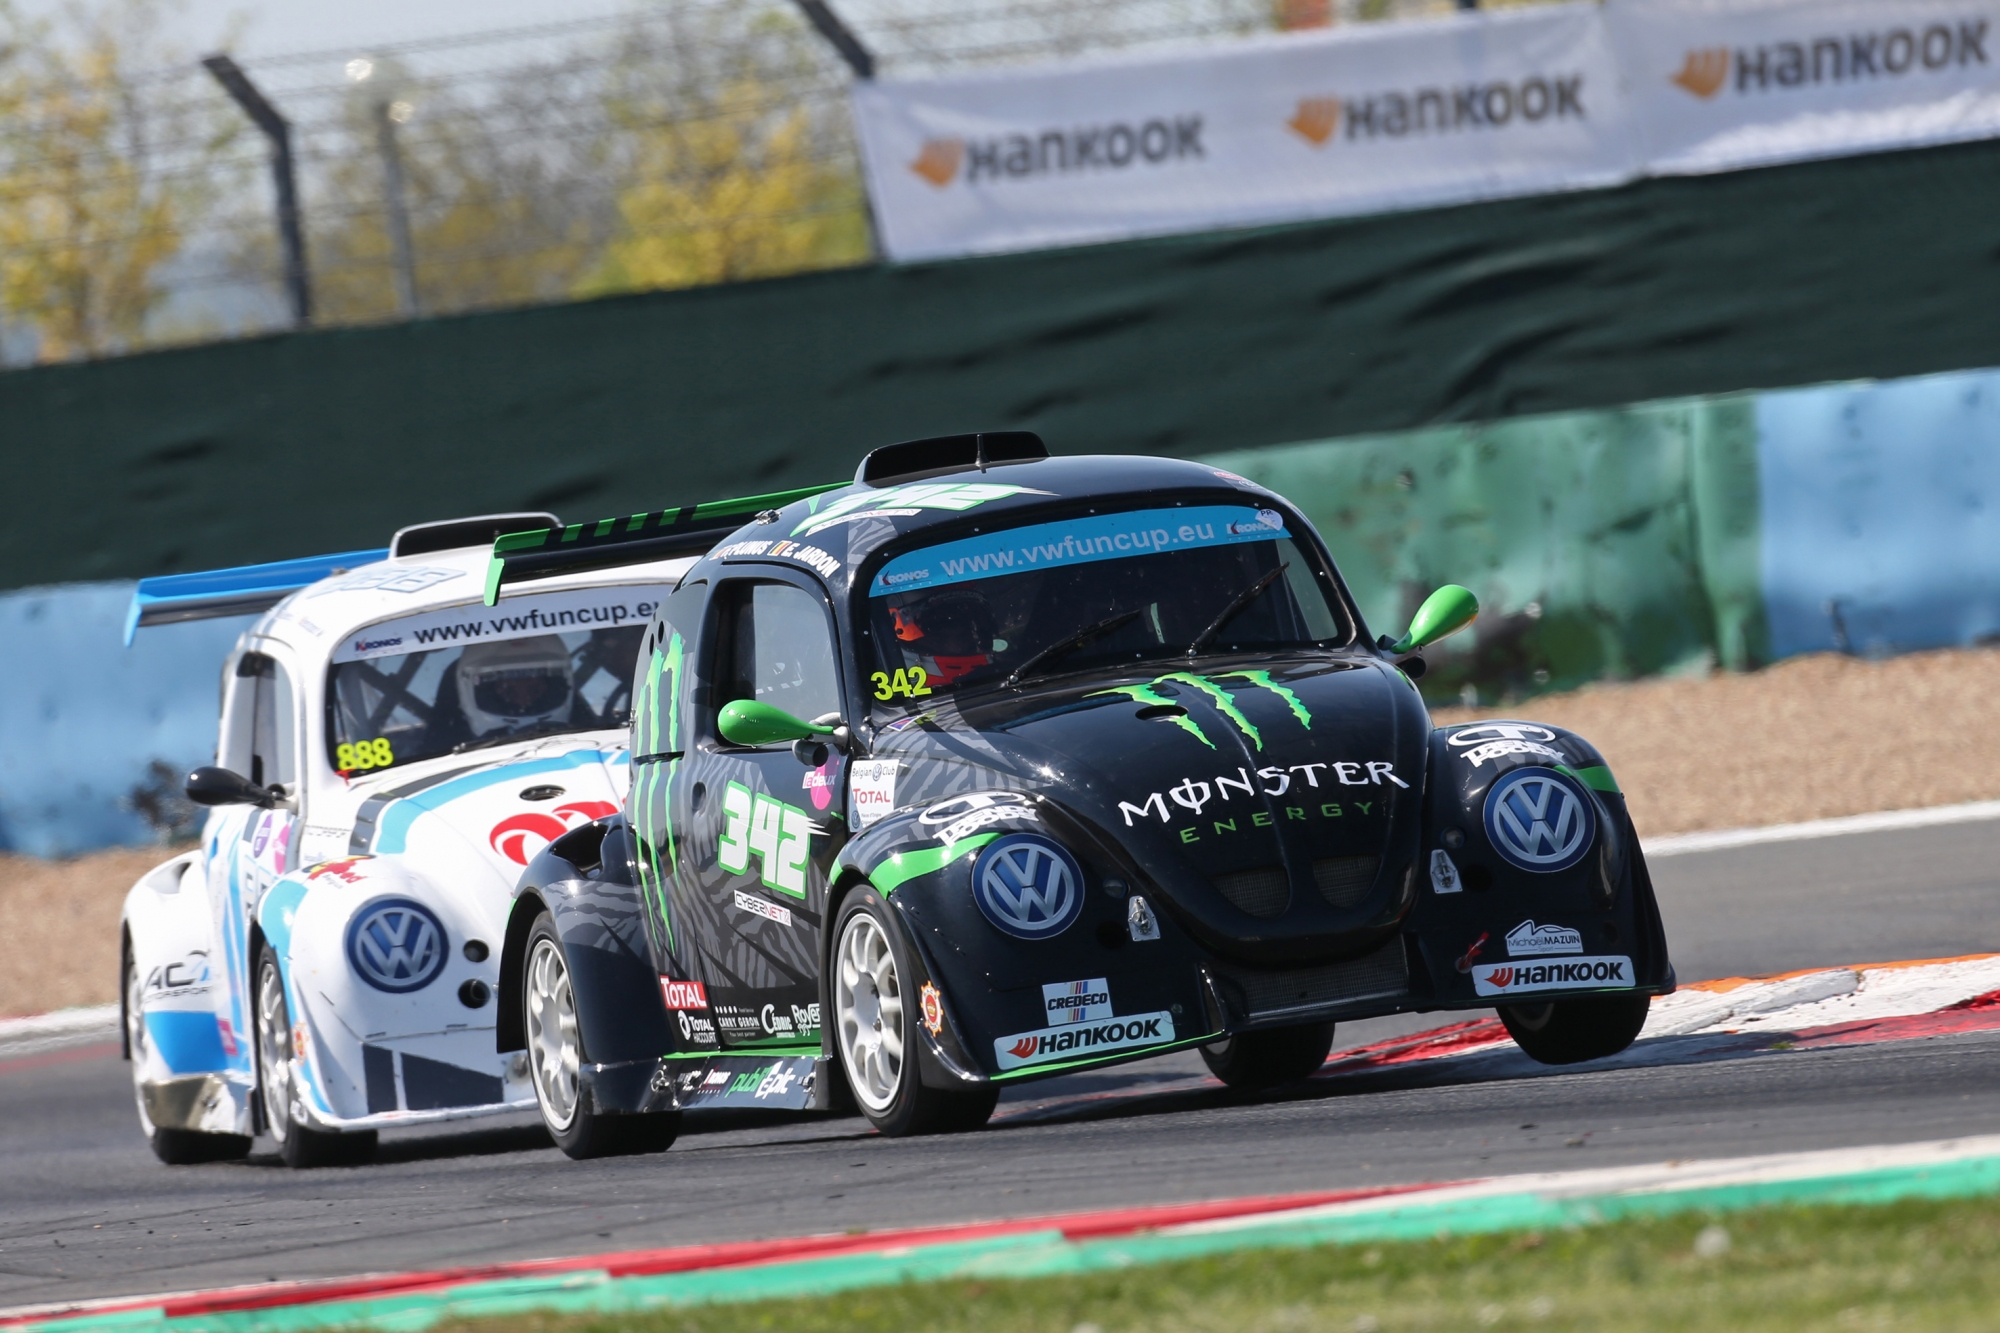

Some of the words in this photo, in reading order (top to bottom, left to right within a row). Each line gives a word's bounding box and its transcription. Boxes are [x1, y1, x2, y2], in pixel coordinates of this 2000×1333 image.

[940, 520, 1214, 576] www.vwfuncup.eu
[793, 545, 841, 579] JARDON
[878, 570, 930, 586] KRONOS
[355, 637, 403, 652] KRONOS
[870, 666, 931, 701] 342
[336, 737, 394, 771] 888
[852, 767, 872, 779] Belgian
[882, 766, 895, 776] Club
[852, 788, 891, 804] TOTAL
[1180, 801, 1373, 845] ENERGY
[718, 780, 825, 900] 342
[660, 977, 707, 1008] TOTAL
[1047, 992, 1108, 1011] CREDECO
[688, 1016, 714, 1031] TOTAL
[738, 1016, 760, 1028] GERON
